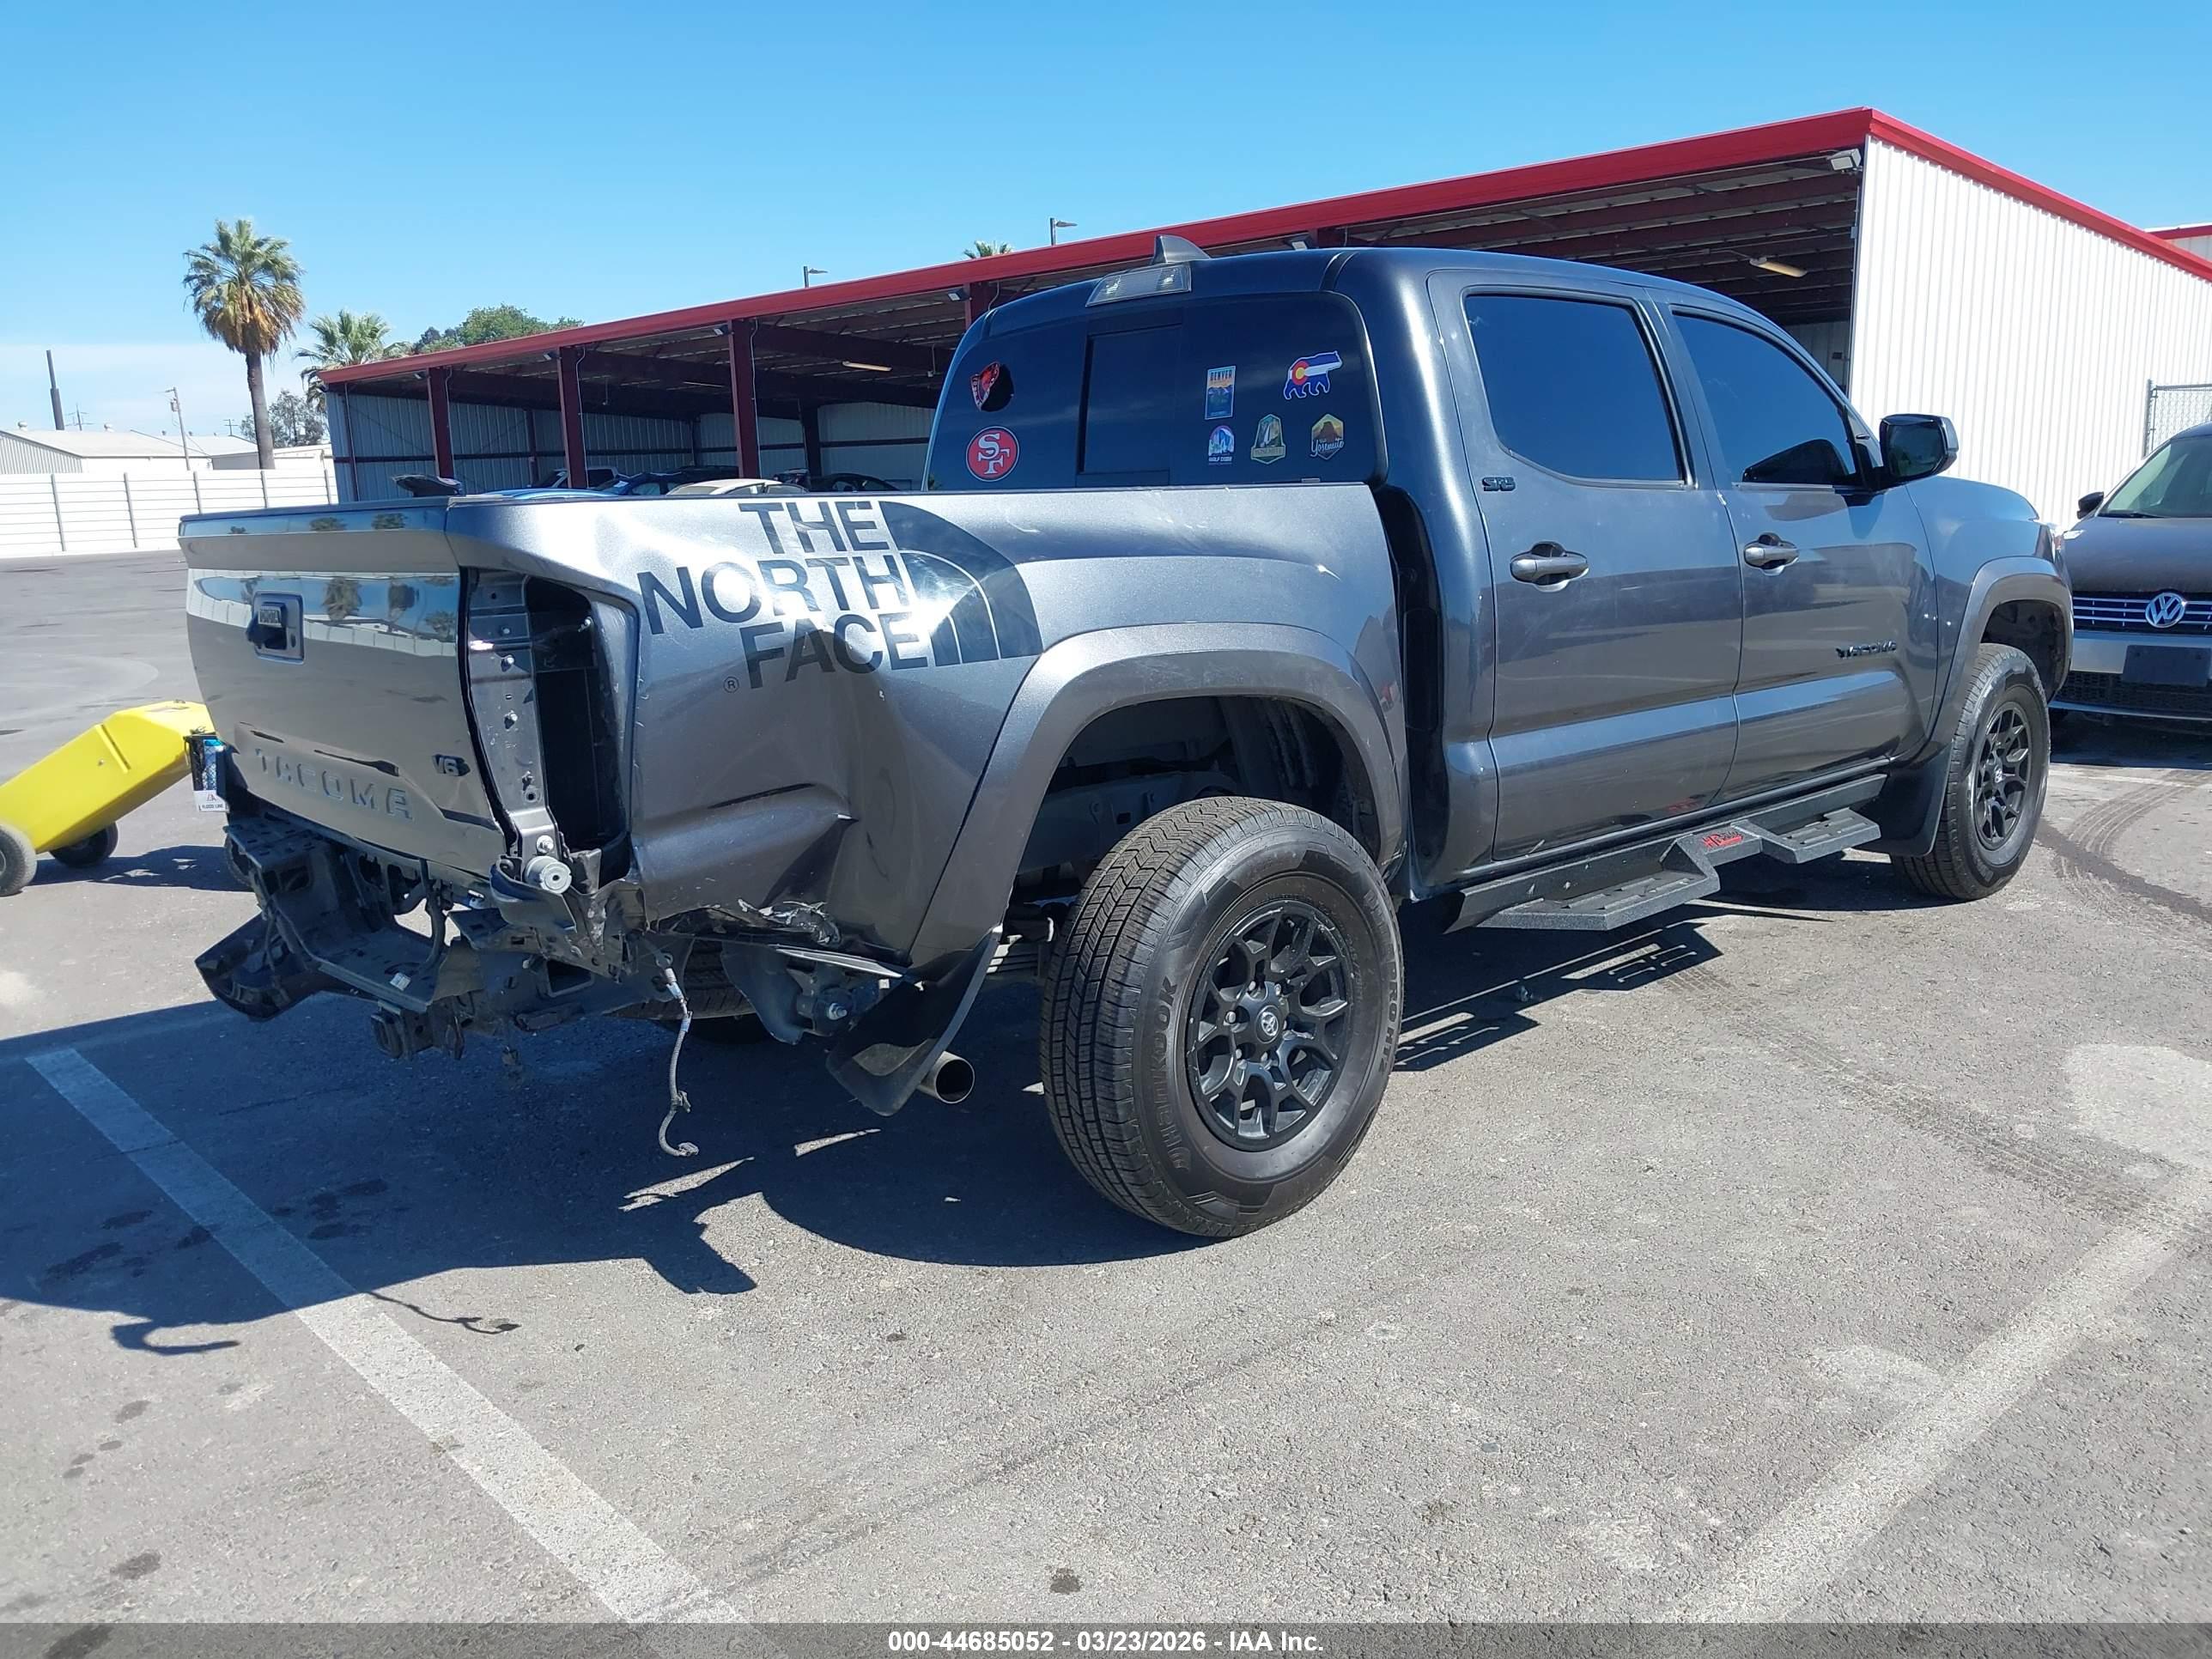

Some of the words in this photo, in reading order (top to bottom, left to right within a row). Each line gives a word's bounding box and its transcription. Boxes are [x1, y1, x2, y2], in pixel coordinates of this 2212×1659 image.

[1310, 439, 1345, 457] Yosemite
[738, 501, 890, 555] THE
[637, 554, 914, 635] NORTH
[739, 611, 928, 690] FACE
[254, 748, 414, 821] TACOMA
